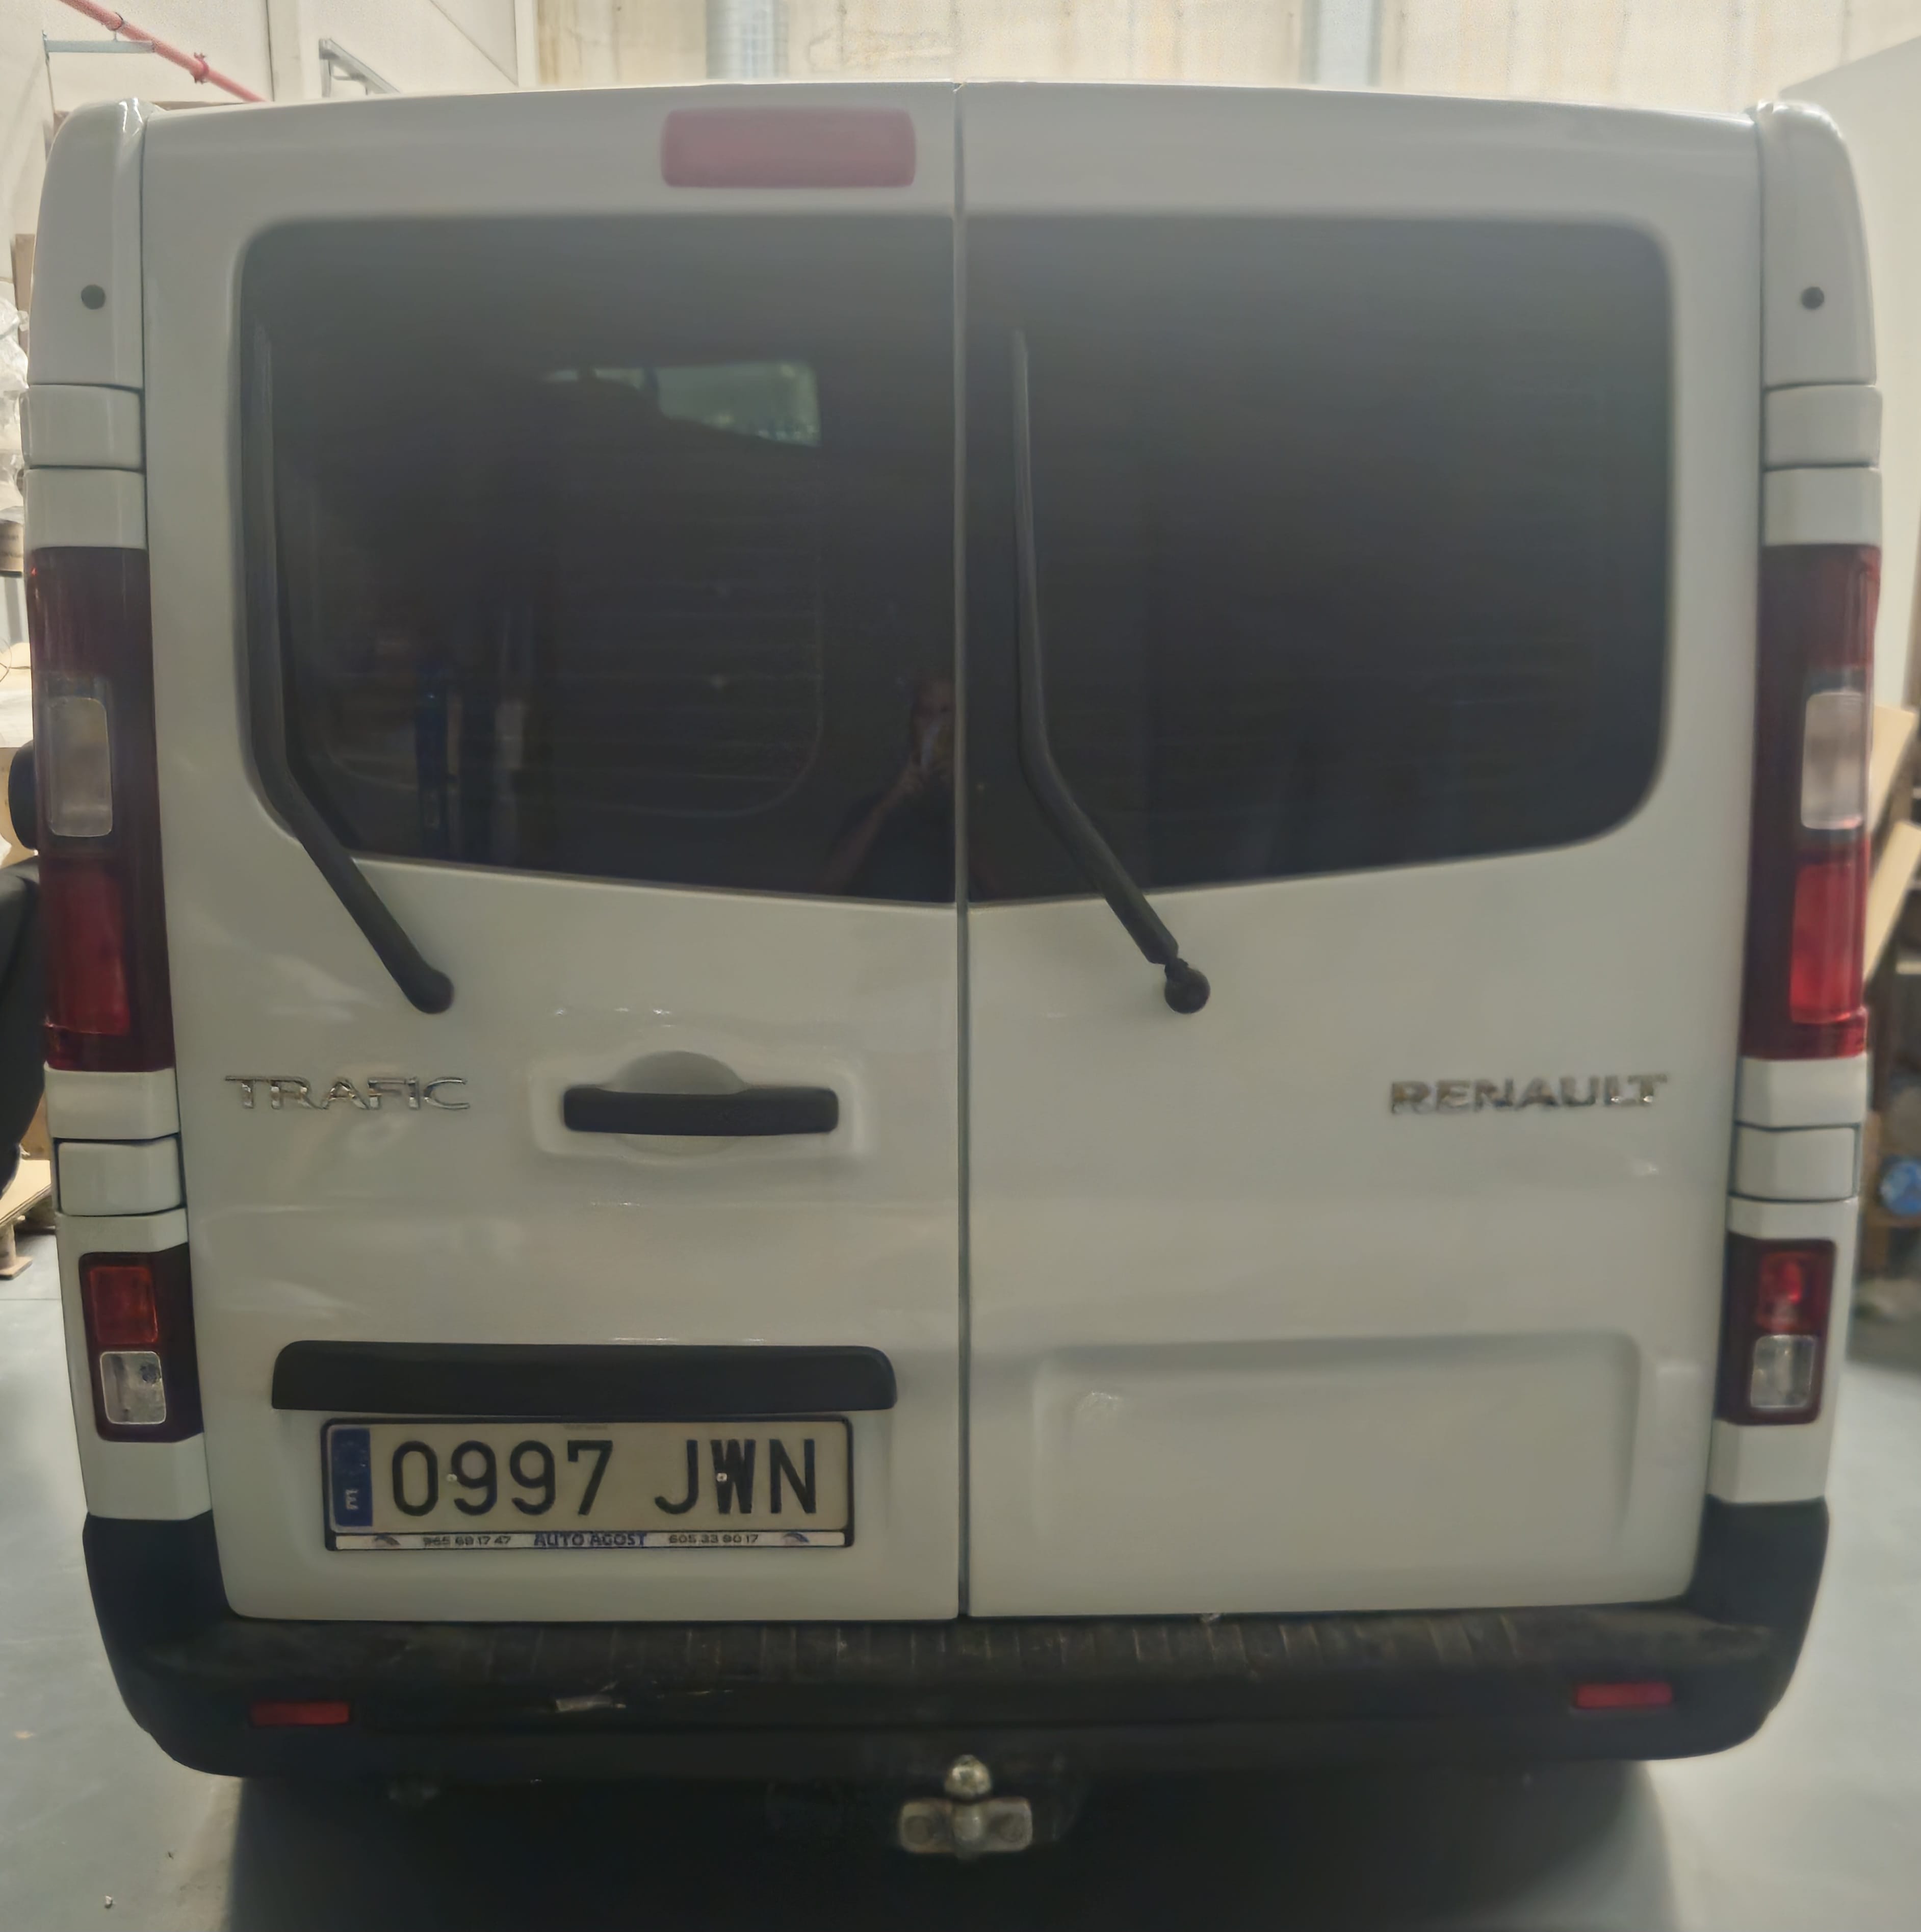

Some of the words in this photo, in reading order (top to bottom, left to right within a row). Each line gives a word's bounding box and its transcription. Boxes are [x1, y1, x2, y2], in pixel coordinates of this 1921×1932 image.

[225, 1075, 470, 1110] TRAFIC
[1391, 1073, 1668, 1115] RENAULT
[345, 1488, 359, 1510] E
[391, 1439, 613, 1517] 0997
[654, 1438, 816, 1515] JWN
[494, 1535, 511, 1545] 47
[534, 1532, 585, 1546] AUTO
[590, 1532, 647, 1546] AGOST
[746, 1534, 759, 1543] 17
